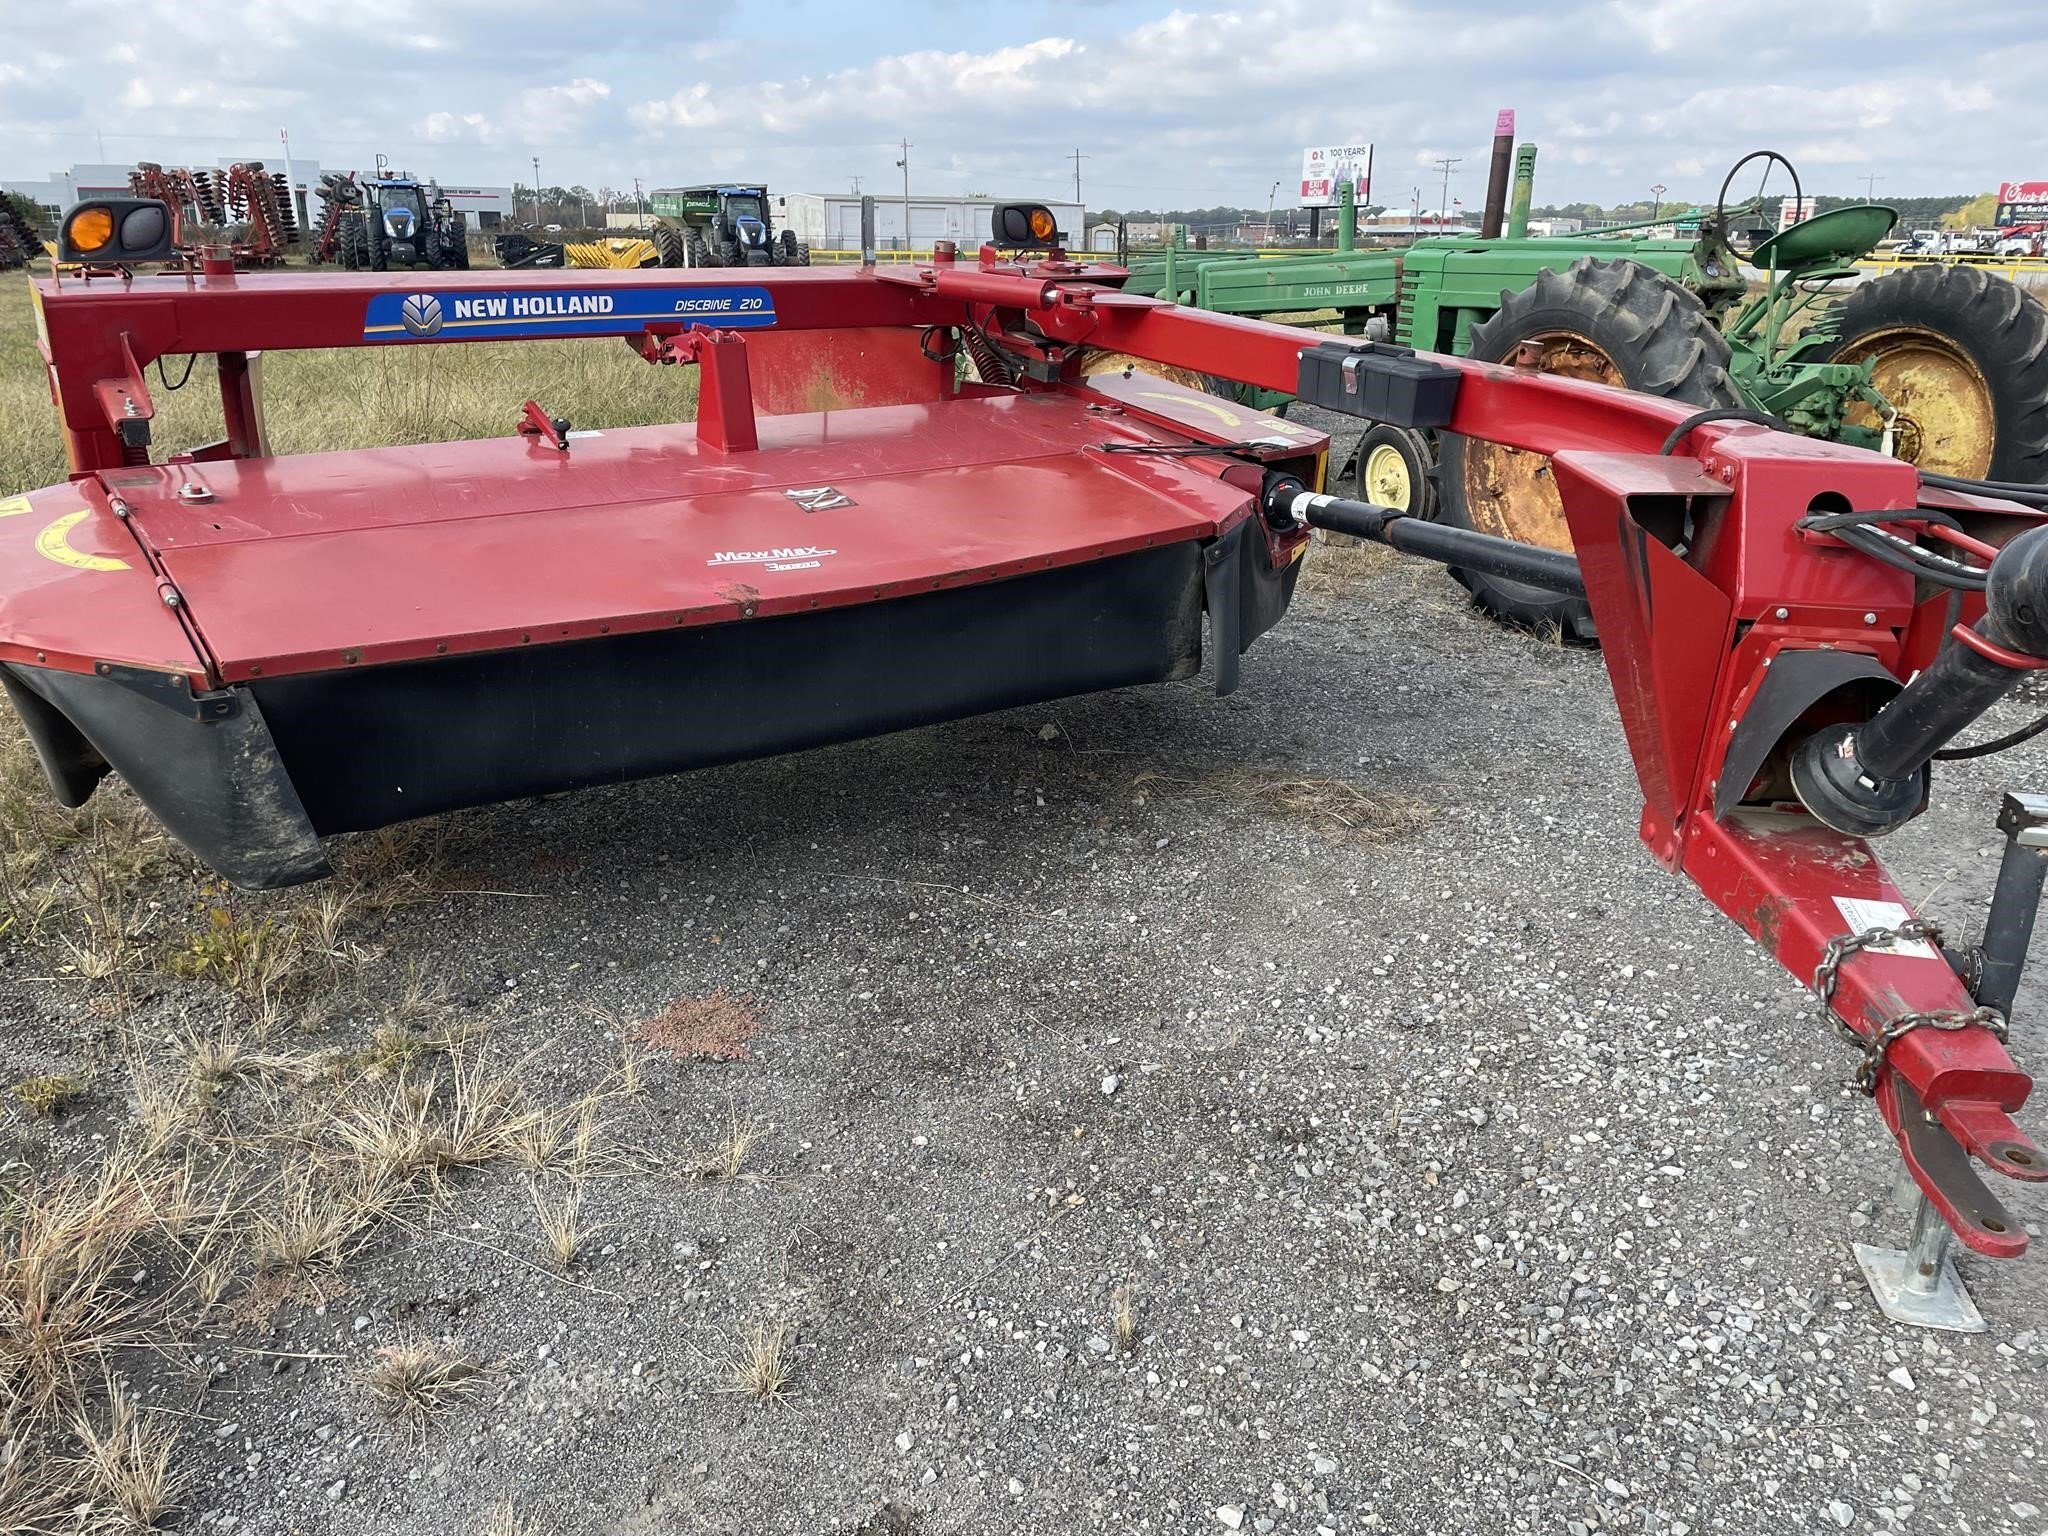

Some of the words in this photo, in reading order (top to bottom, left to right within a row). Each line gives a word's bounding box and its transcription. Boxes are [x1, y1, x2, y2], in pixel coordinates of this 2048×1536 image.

[1330, 148, 1342, 158] 100
[1344, 146, 1366, 156] YEARS
[1308, 188, 1324, 196] NOW
[1303, 286, 1331, 297] JOHN
[1335, 283, 1369, 295] DEERE
[454, 298, 508, 319] NEW
[512, 295, 614, 316] HOLLAND
[674, 298, 732, 311] DISCBINE
[739, 298, 763, 310] 210
